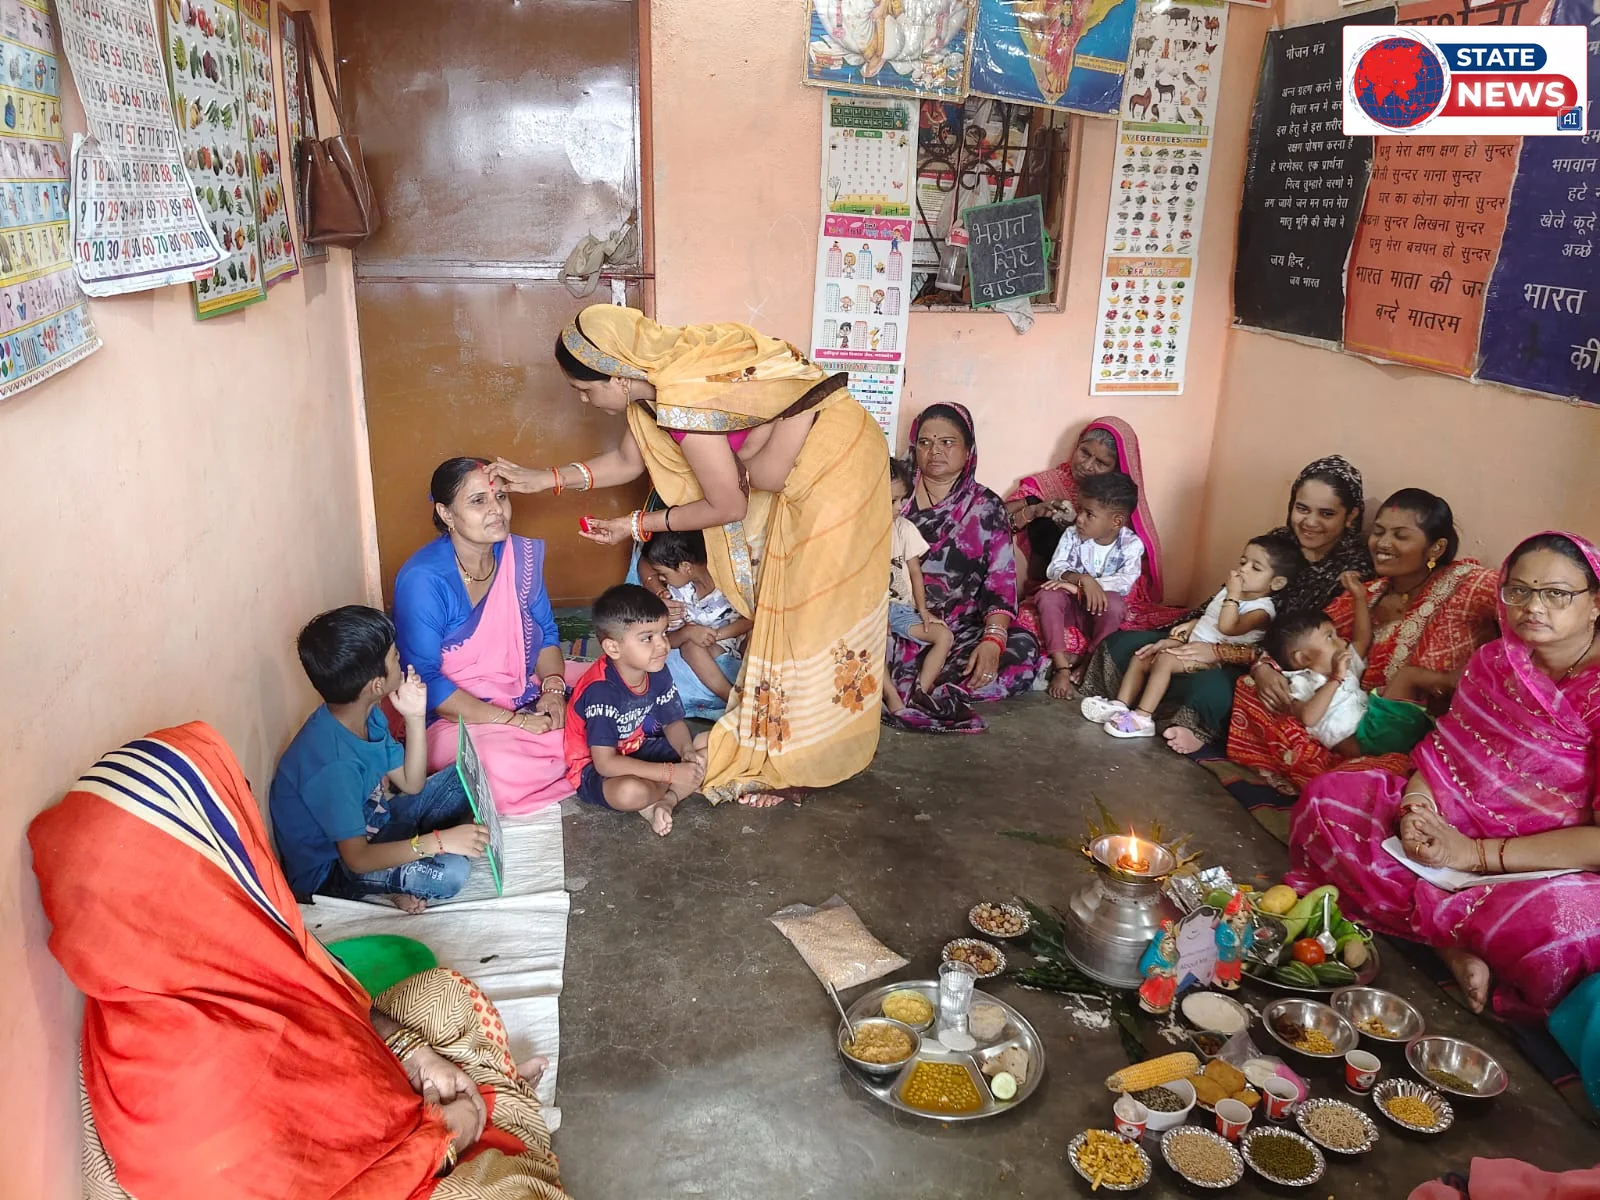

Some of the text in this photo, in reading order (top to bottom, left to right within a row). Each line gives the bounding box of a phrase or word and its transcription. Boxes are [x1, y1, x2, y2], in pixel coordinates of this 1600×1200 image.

[1315, 78, 1332, 93] करने
[1326, 140, 1346, 151] करना
[1396, 141, 1412, 157] मेरा
[1416, 145, 1436, 157] क्षण
[1439, 145, 1459, 157] क्षण
[1464, 140, 1478, 158] हो
[1484, 144, 1514, 162] सुन्दर
[81, 159, 87, 181] 8
[93, 160, 105, 182] 18
[160, 163, 173, 182] 88
[172, 164, 184, 182] 98
[1392, 168, 1420, 185] सुन्दर
[1423, 169, 1447, 182] गाना
[1452, 170, 1482, 187] सुन्दर
[1552, 158, 1599, 173] भगवान
[1395, 192, 1408, 204] का
[1412, 190, 1438, 207] कोना
[1442, 191, 1471, 208] कोना
[1475, 196, 1506, 214] सुन्दर
[1567, 182, 1588, 201] हटे
[81, 201, 87, 222] 9
[93, 201, 105, 222] 19
[108, 200, 119, 221] 29
[146, 201, 156, 219] 69
[156, 199, 169, 218] 79
[169, 199, 182, 217] 89
[182, 198, 194, 216] 99
[1310, 214, 1320, 228] की
[1323, 214, 1337, 228] सेवा
[1540, 209, 1598, 235] खेले कूदे
[972, 213, 1033, 245] भगत
[1384, 216, 1409, 231] सुन्दर
[1413, 214, 1451, 231] लिखना
[1455, 221, 1486, 238] सुन्दर
[92, 240, 105, 262] 20
[107, 240, 119, 260] 30
[142, 237, 155, 256] 60
[154, 235, 169, 253] 70
[168, 234, 182, 252] 80
[180, 232, 194, 249] 90
[191, 231, 209, 249] 100
[1386, 235, 1402, 251] मेरा
[1406, 241, 1437, 256] बचपन
[1442, 241, 1455, 257] हो
[1461, 247, 1492, 264] सुन्दर
[1561, 239, 1593, 258] अच्छे
[1270, 254, 1284, 267] जय
[1356, 266, 1384, 286] भारत
[1390, 270, 1423, 290] माता
[1429, 270, 1453, 295] की
[1523, 282, 1588, 315] भारत
[1407, 308, 1463, 334] मातरम
[1569, 337, 1600, 375] की
